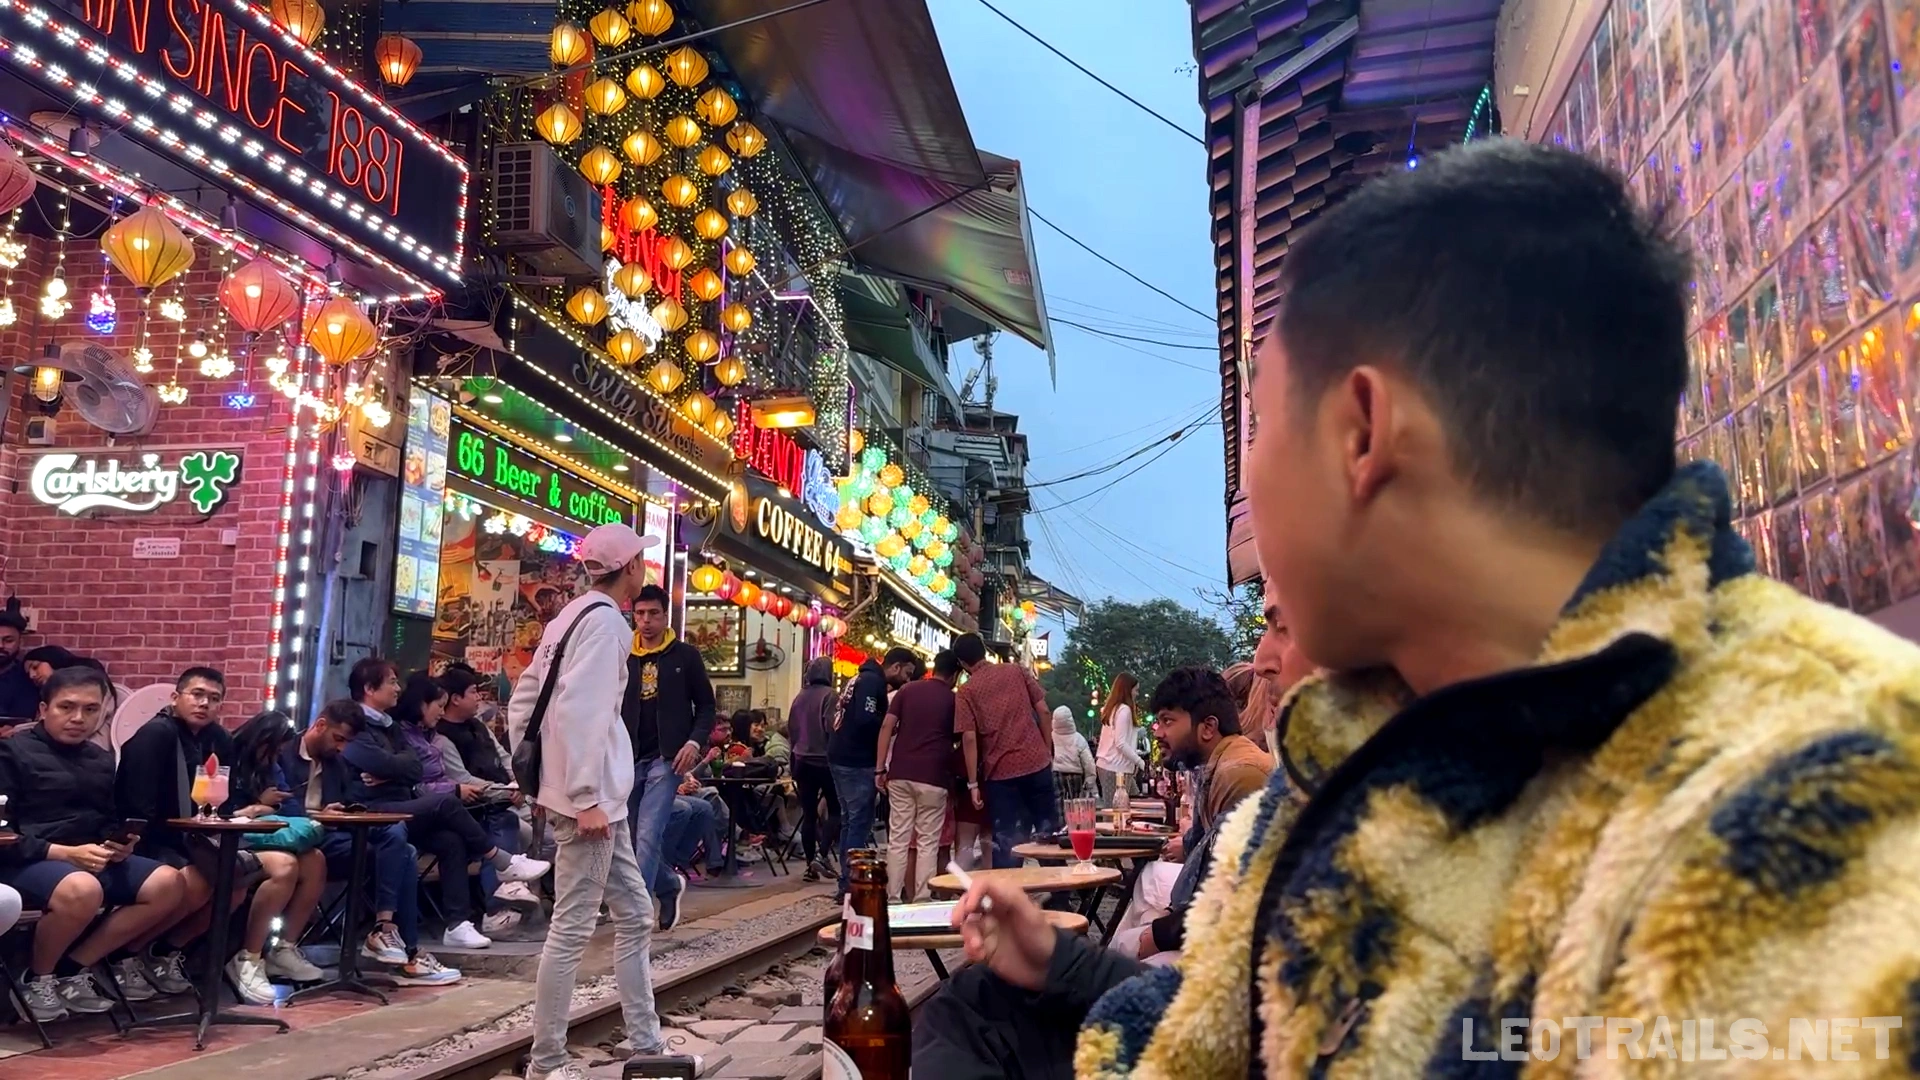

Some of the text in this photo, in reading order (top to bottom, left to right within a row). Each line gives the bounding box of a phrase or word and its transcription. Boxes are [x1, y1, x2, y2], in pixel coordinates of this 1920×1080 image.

[162, 0, 403, 217] SINCE 1881
[572, 351, 638, 421] Sixty
[32, 453, 179, 516] Carlsberg
[458, 432, 485, 476] 66
[494, 447, 542, 498] Beer
[549, 473, 562, 509] &
[569, 491, 622, 525] coffee
[758, 497, 823, 568] COFFEE
[824, 540, 840, 576] 64
[61, 985, 80, 1000] N
